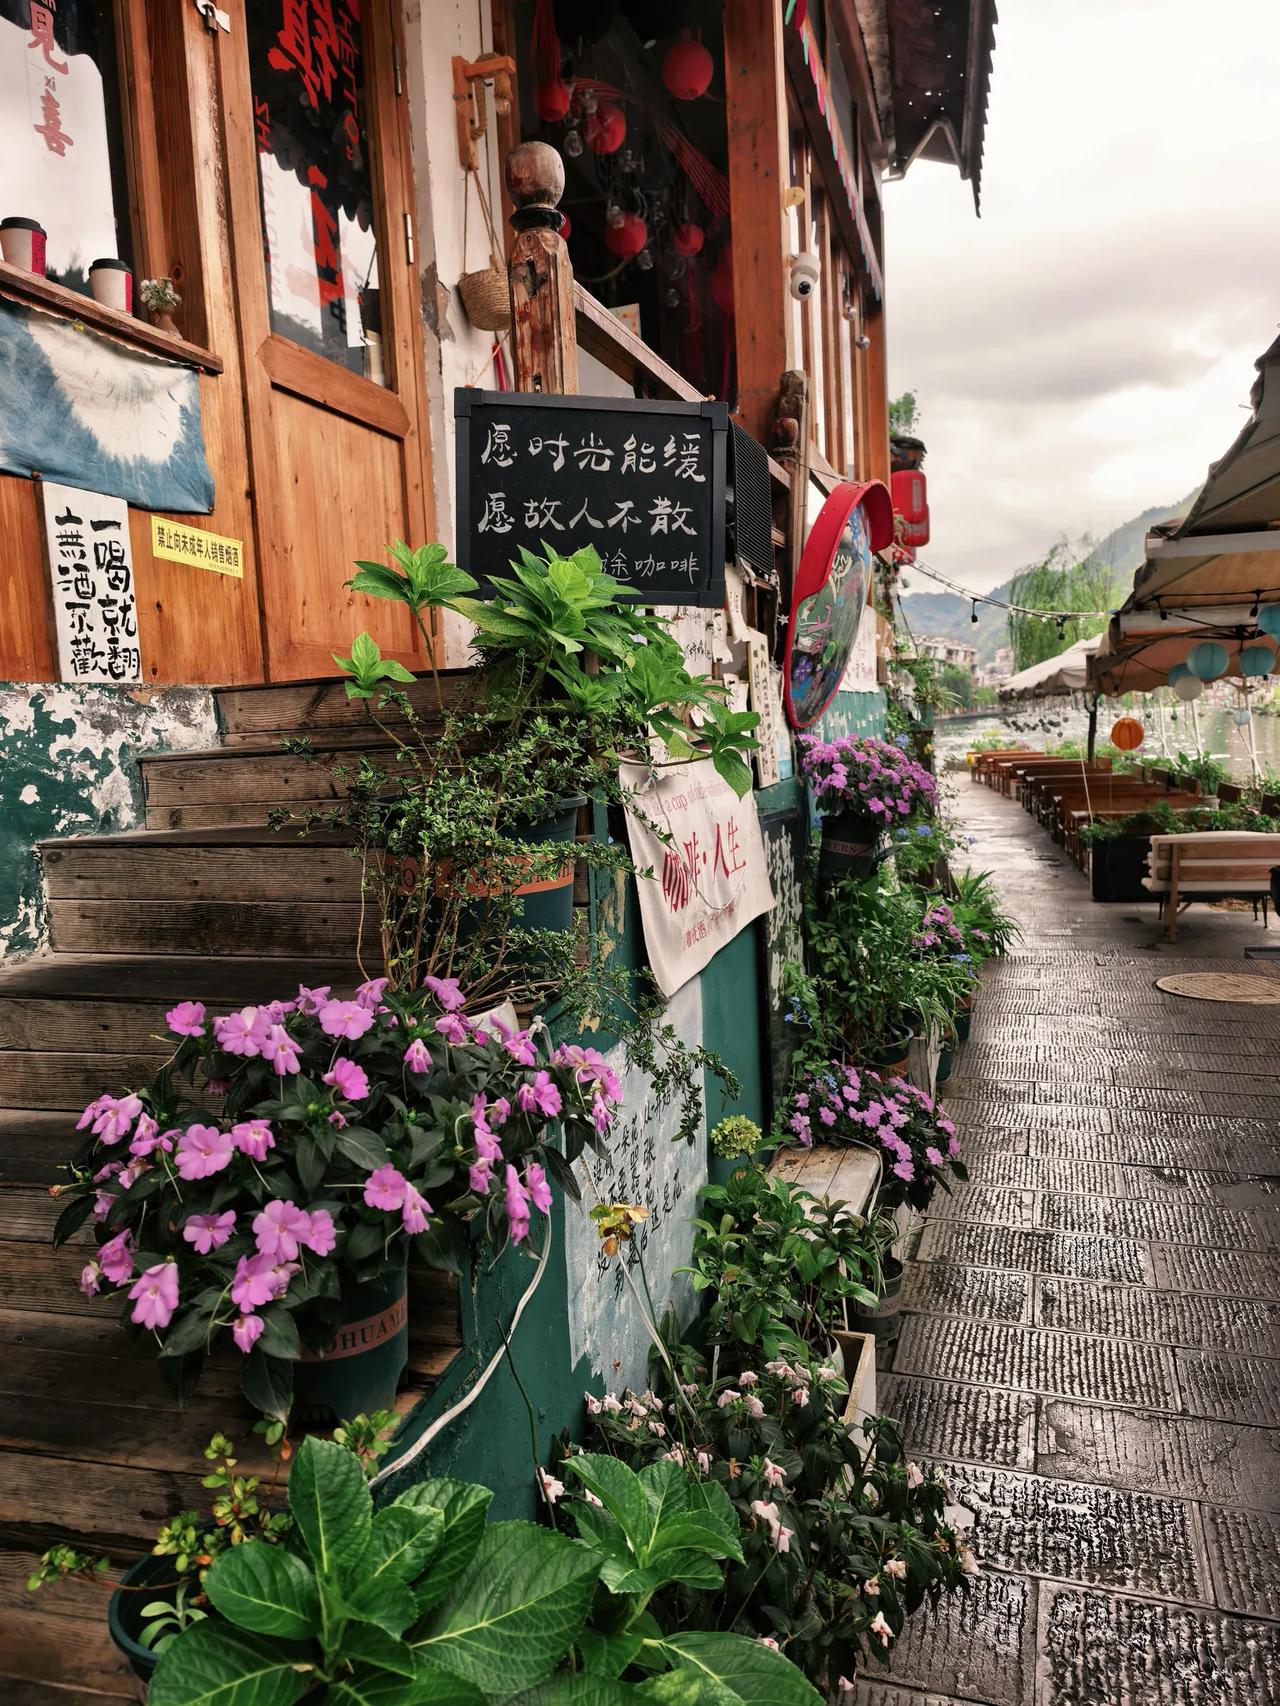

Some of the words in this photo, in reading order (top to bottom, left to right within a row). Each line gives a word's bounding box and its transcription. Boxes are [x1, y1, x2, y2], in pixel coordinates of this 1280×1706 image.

[481, 422, 706, 482] 愿时光能缓
[478, 492, 698, 536] 愿故人不散
[157, 525, 239, 567] 禁止向未成年人销售烟酒
[600, 547, 700, 585] 途咖啡
[90, 519, 140, 682] 一喝就翻
